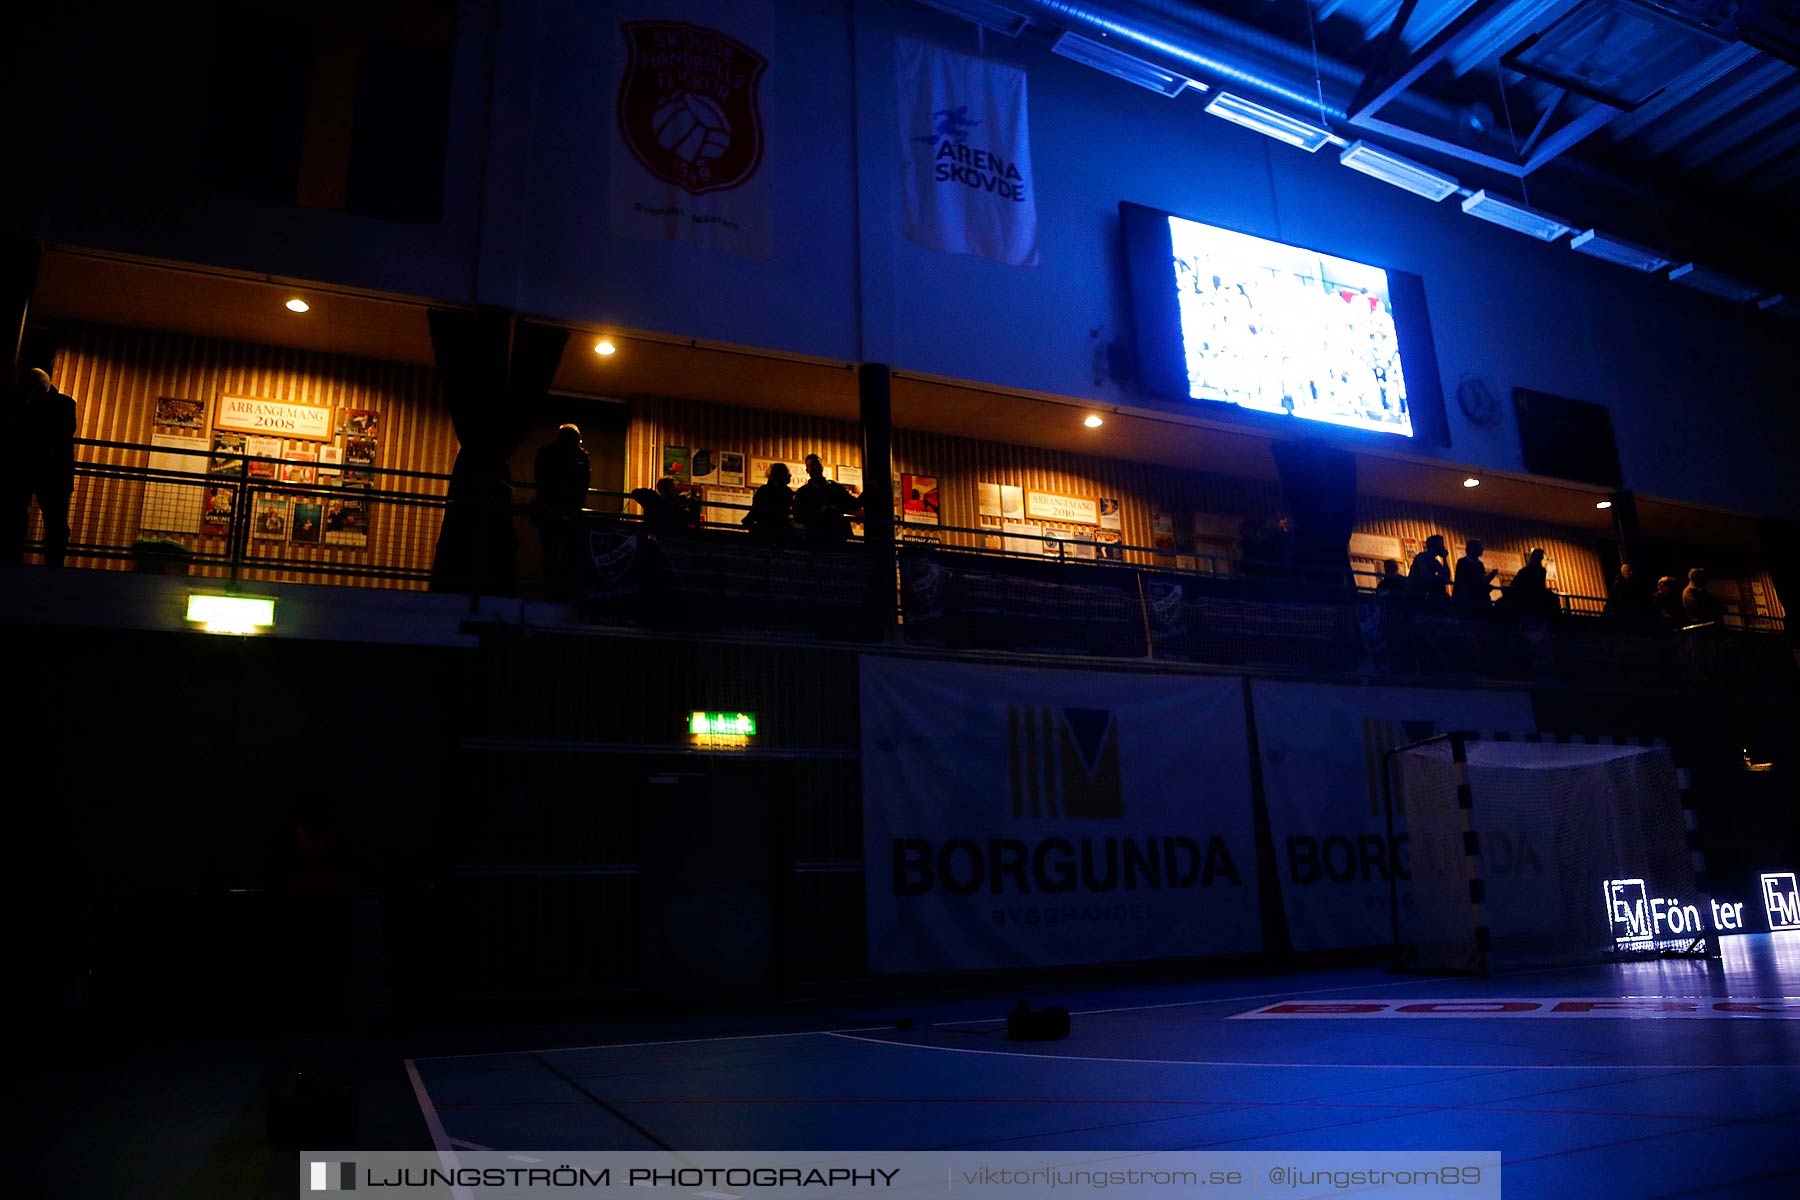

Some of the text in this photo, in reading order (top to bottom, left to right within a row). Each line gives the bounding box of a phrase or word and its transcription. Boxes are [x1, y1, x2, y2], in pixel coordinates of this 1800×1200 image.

[936, 140, 1023, 181] ARENA
[227, 401, 323, 421] ARRANGEMANG
[254, 416, 295, 430] 2008
[1032, 495, 1093, 511] ARRANGEMANG
[1052, 507, 1075, 518] 2010
[892, 836, 1243, 896] BORGUNDA
[992, 902, 1153, 927] BYGGHANDEL
[1650, 898, 1744, 935] Fönter
